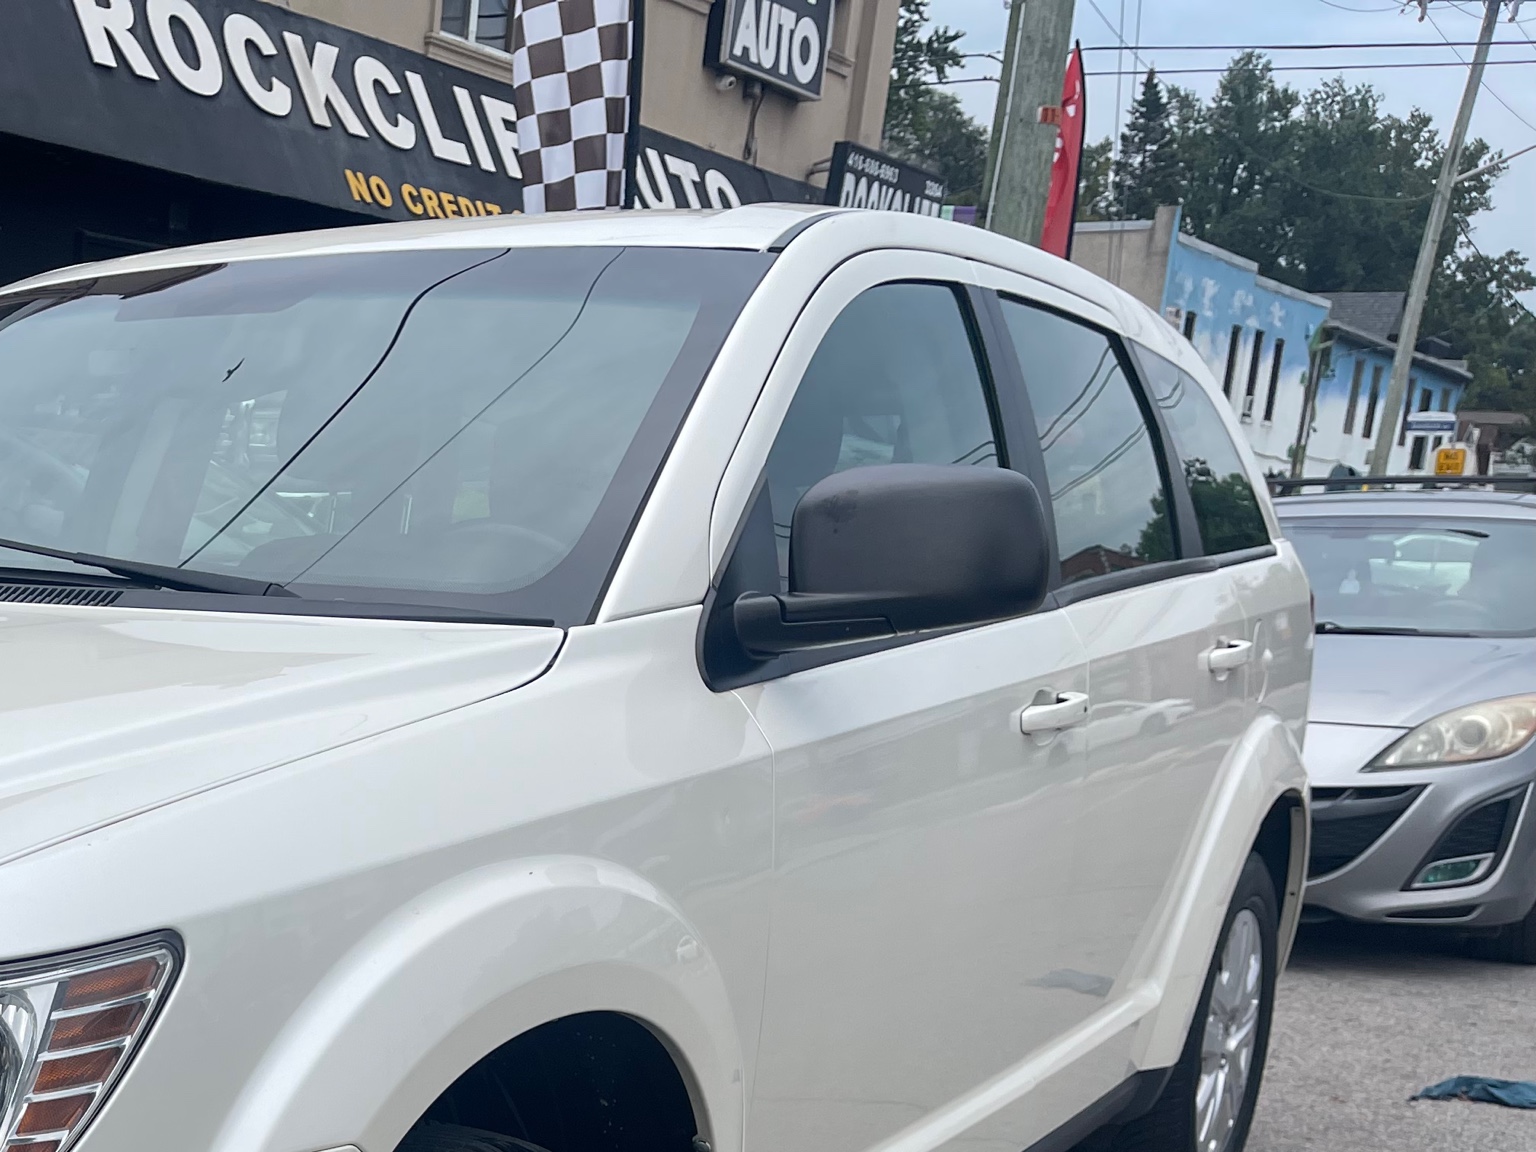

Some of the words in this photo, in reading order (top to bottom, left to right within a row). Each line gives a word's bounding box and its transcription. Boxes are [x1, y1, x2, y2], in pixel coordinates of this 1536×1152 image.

[732, 0, 821, 84] AUTO
[74, 0, 523, 180] ROCKCLIF
[634, 147, 742, 209] UTO
[344, 168, 393, 208] NO
